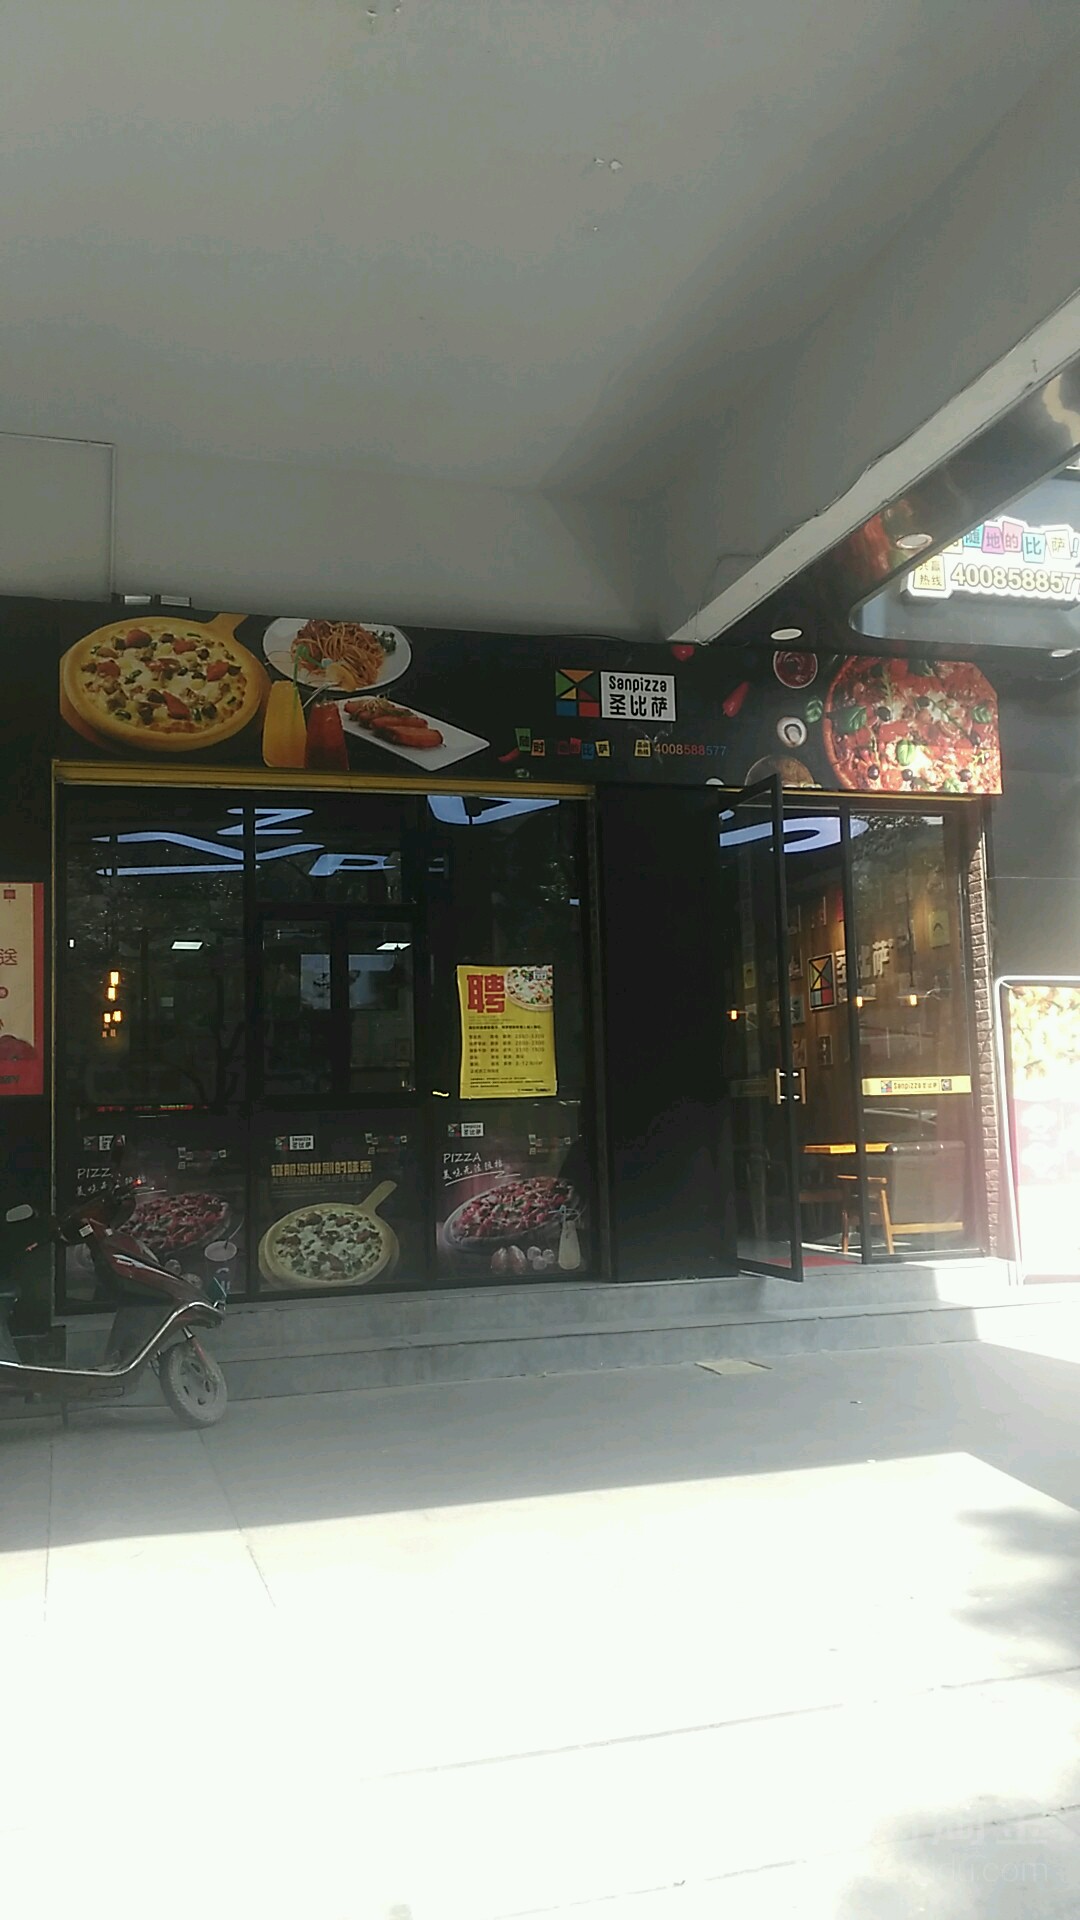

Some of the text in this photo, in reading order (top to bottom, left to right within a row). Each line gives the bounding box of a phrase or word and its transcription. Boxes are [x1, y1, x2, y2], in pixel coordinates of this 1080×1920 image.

[608, 675, 667, 693] Sanpizza
[609, 693, 668, 717] 圣比萨
[654, 743, 727, 757] 4008588577
[467, 974, 505, 1013] 聘
[443, 1152, 482, 1165] PIZZA
